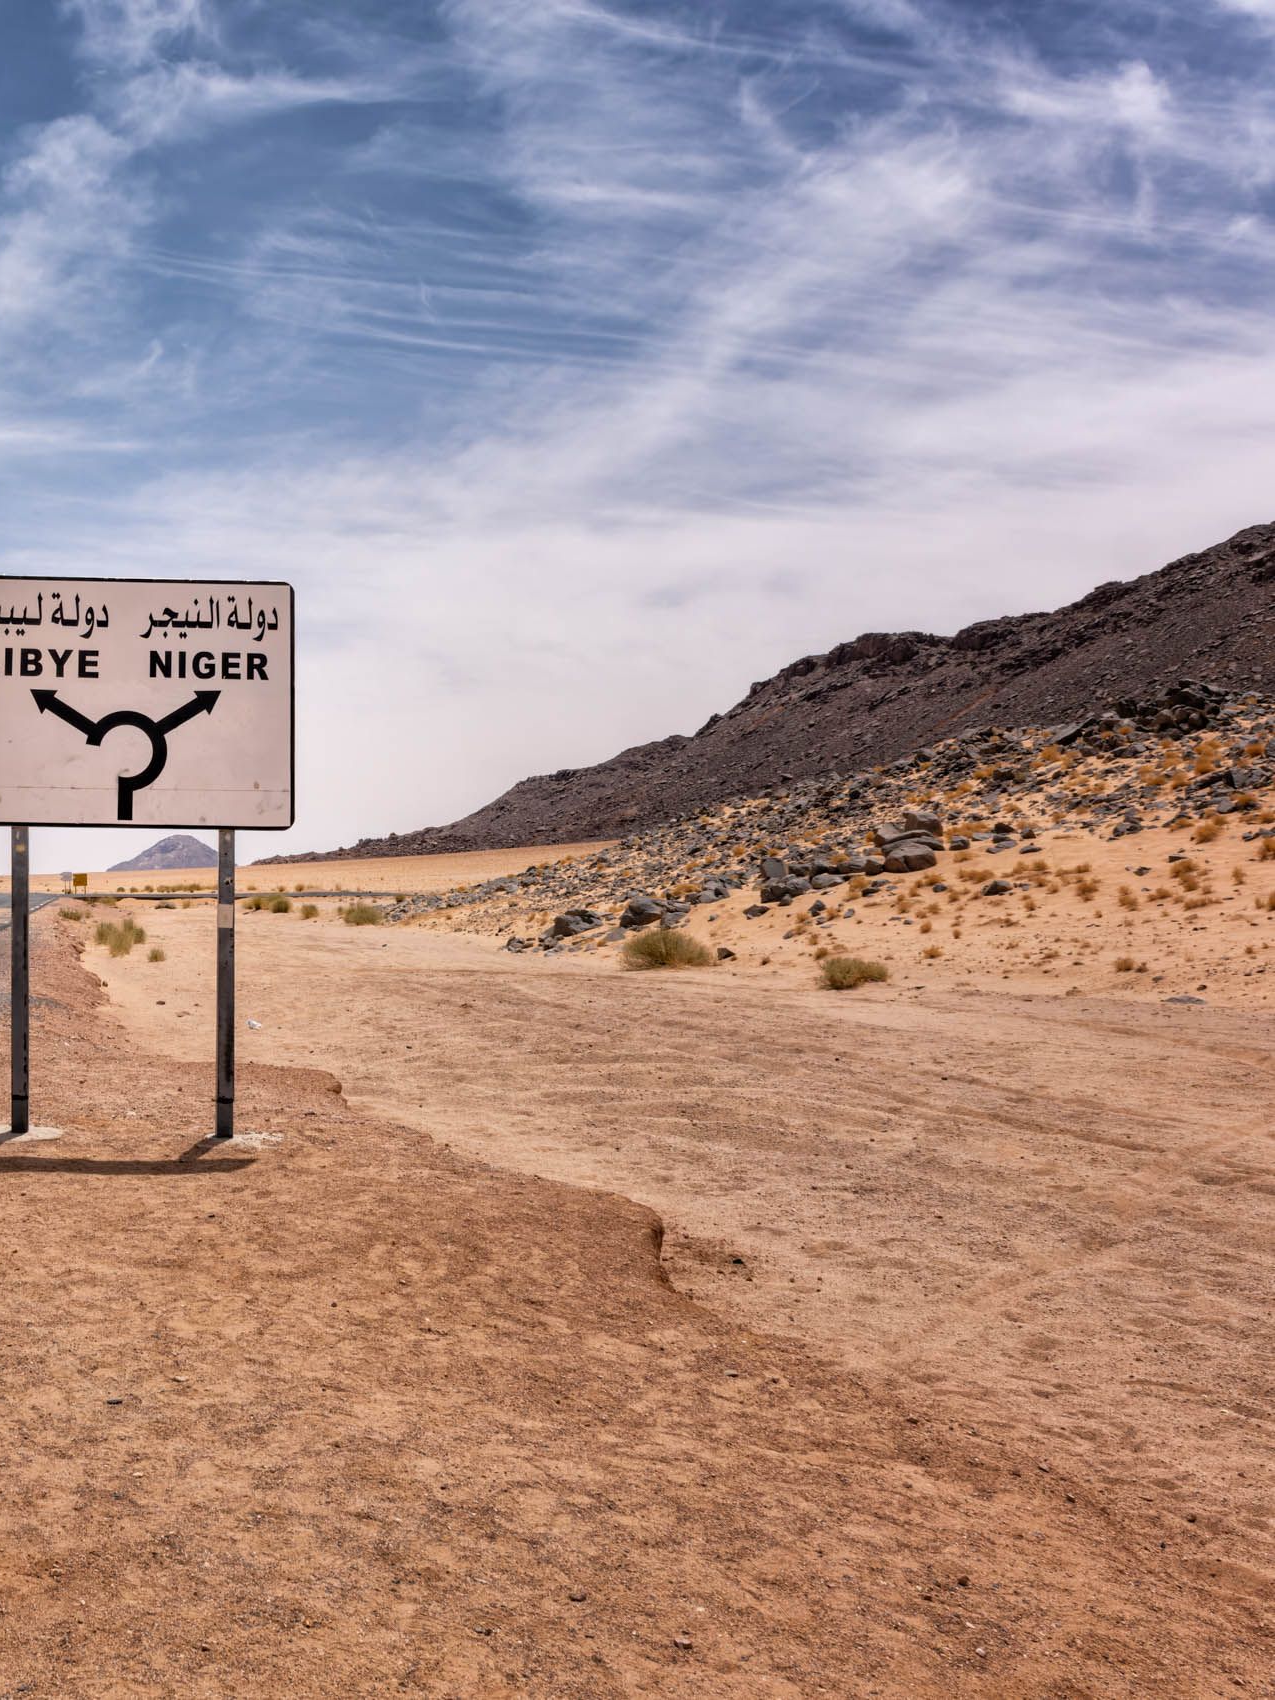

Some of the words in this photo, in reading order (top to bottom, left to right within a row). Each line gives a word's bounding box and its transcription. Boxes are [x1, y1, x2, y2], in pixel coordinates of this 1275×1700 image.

[51, 592, 109, 639] دولة
[139, 595, 220, 639] النيجر
[227, 595, 279, 642] دولة
[149, 650, 269, 681] NIGER
